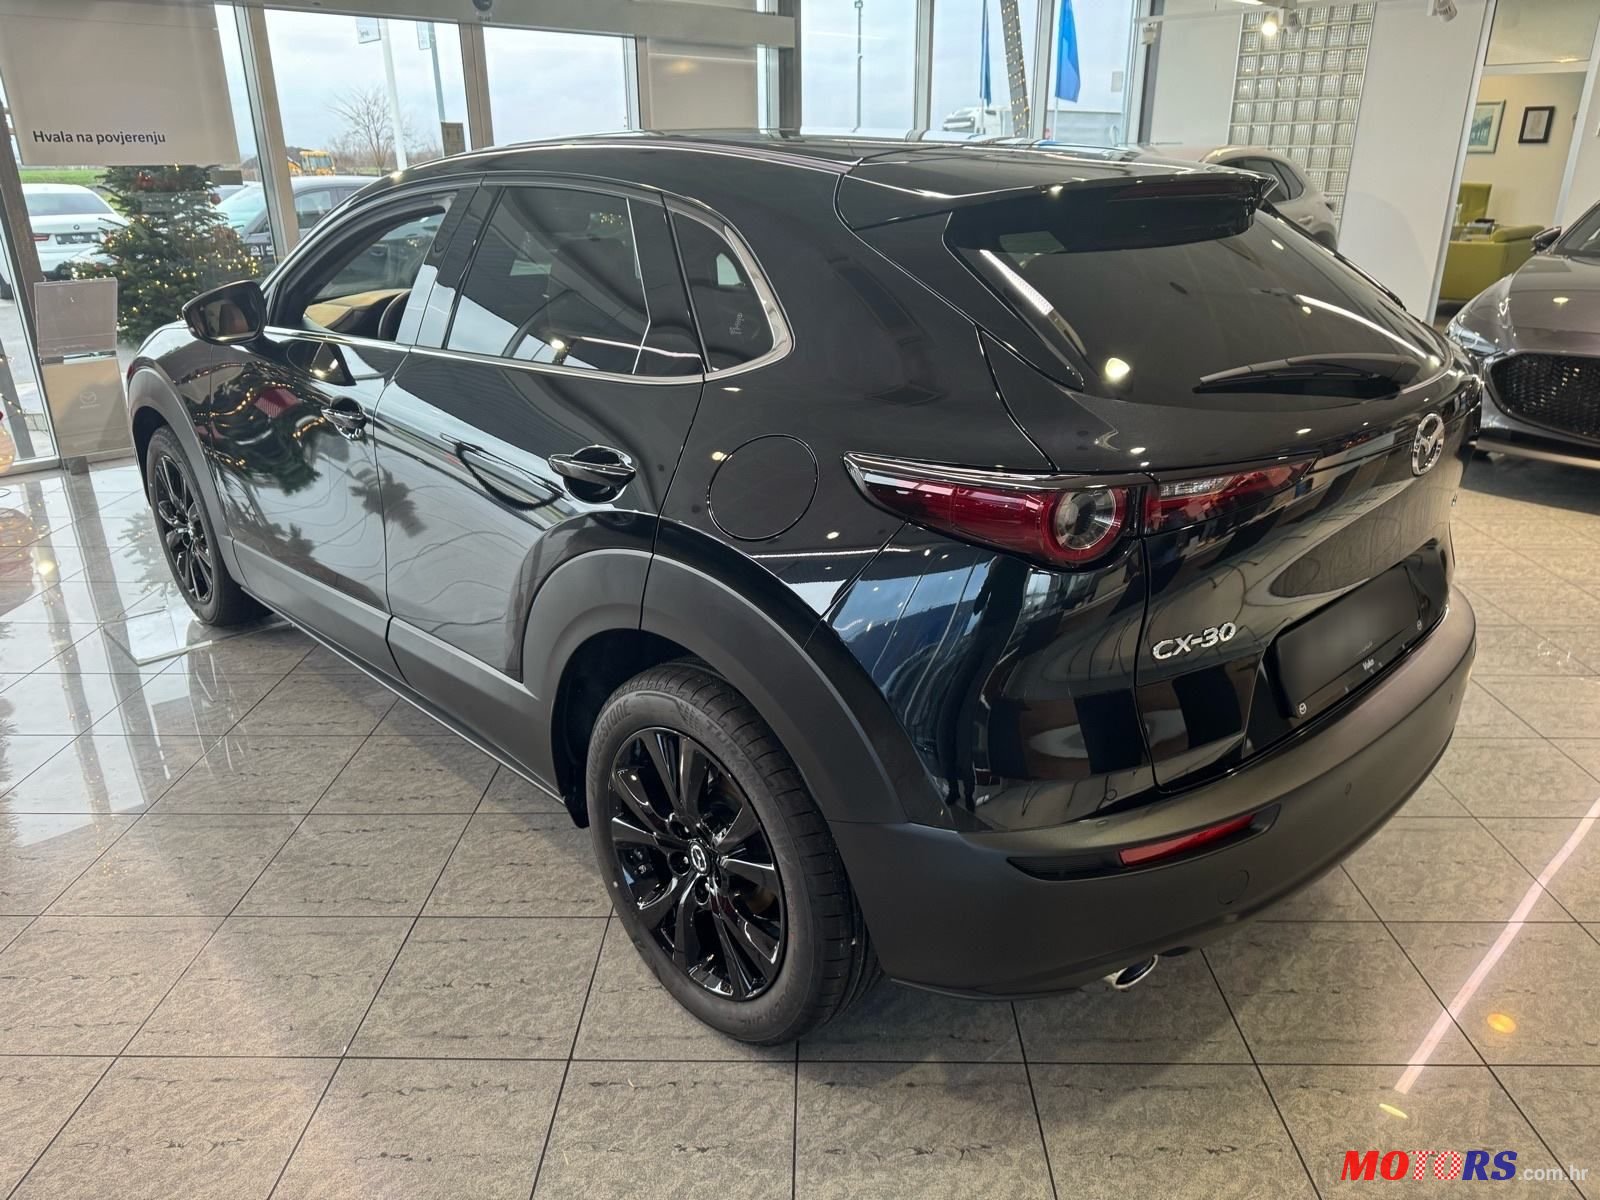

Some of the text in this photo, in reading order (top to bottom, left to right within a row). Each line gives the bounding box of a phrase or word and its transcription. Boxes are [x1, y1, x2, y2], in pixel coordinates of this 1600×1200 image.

[33, 131, 166, 145] Hvala na povjerenju
[1152, 622, 1237, 660] CX-30
